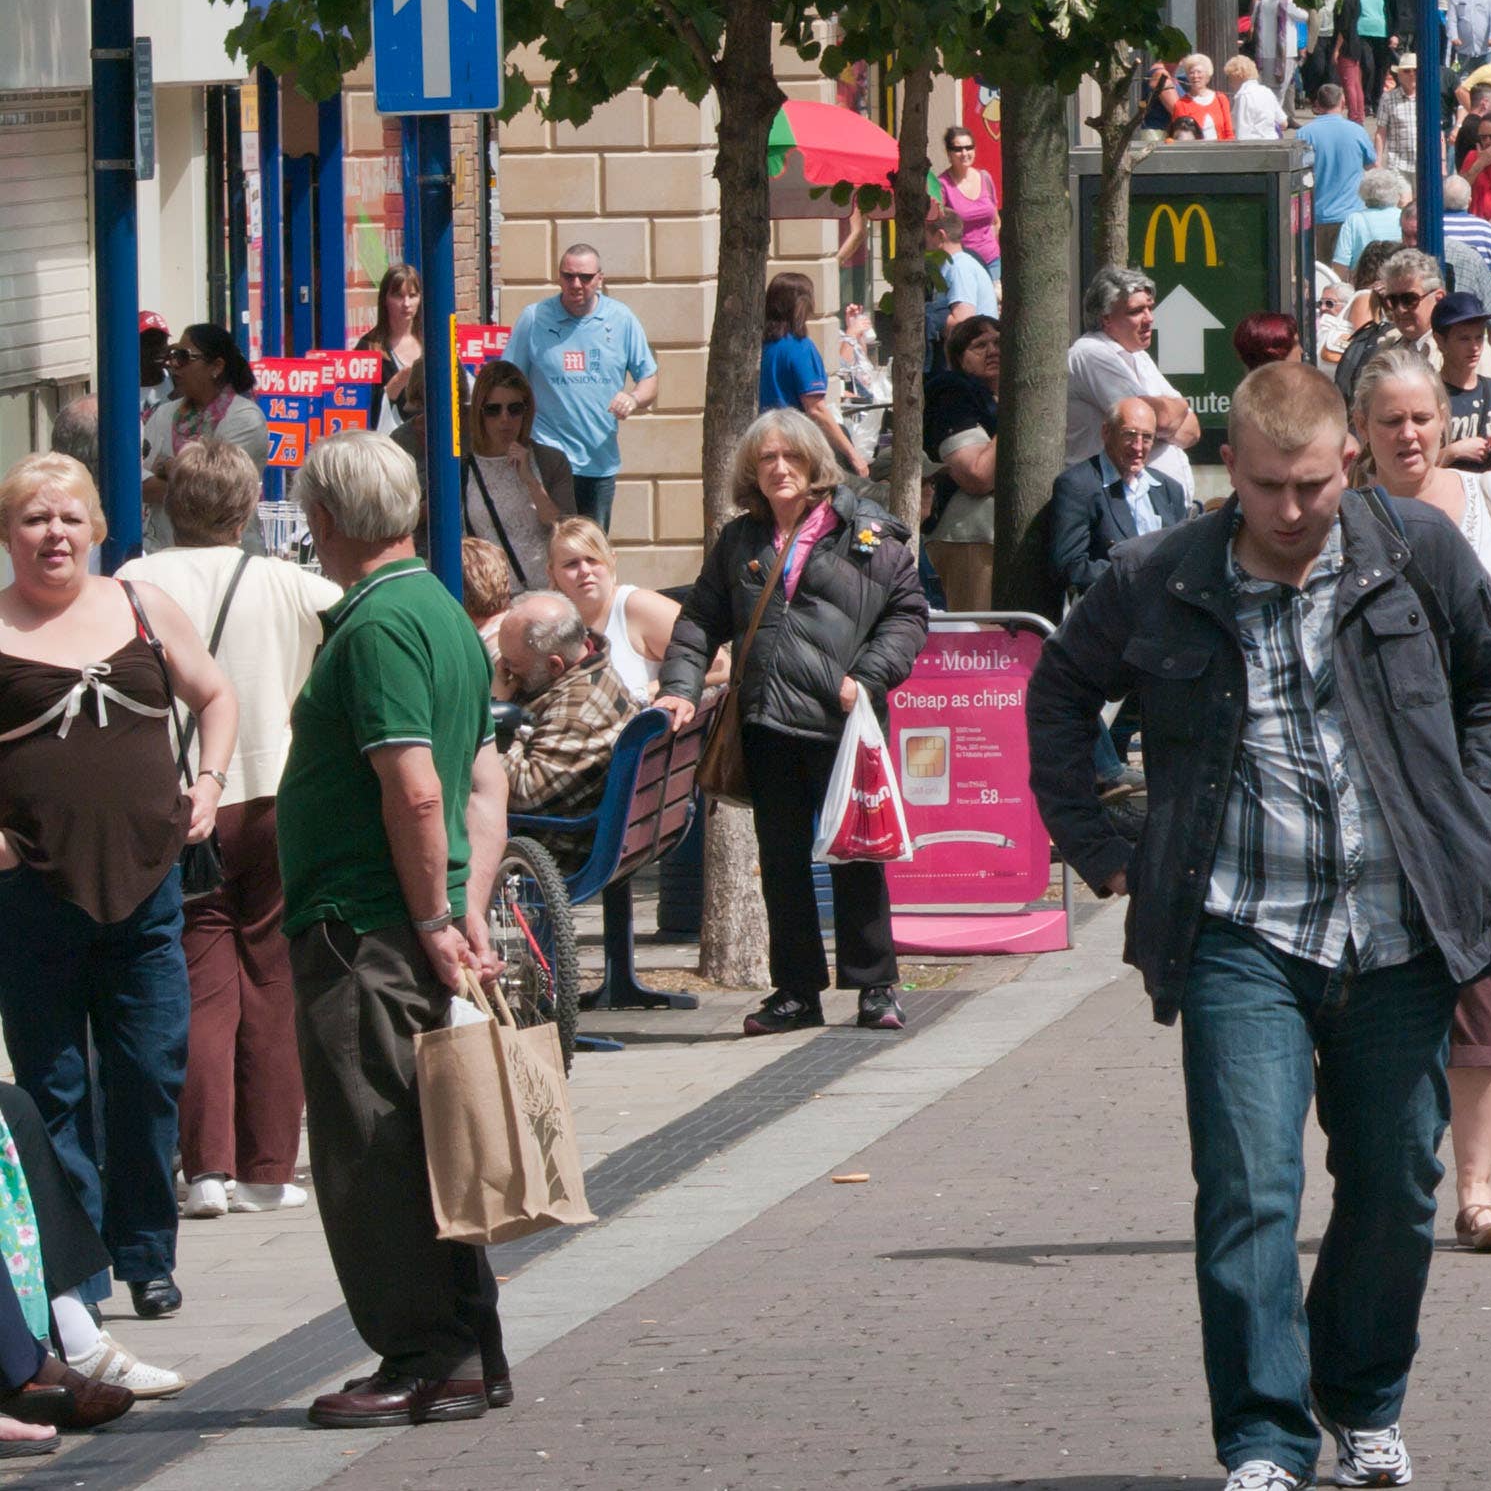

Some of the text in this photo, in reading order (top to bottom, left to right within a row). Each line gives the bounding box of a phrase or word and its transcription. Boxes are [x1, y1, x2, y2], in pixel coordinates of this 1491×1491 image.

[349, 358, 378, 379] OFF
[288, 370, 319, 392] OFF
[941, 649, 1011, 671] Mobile
[894, 689, 1023, 711] Cheap as chips!
[980, 788, 999, 805] £8
